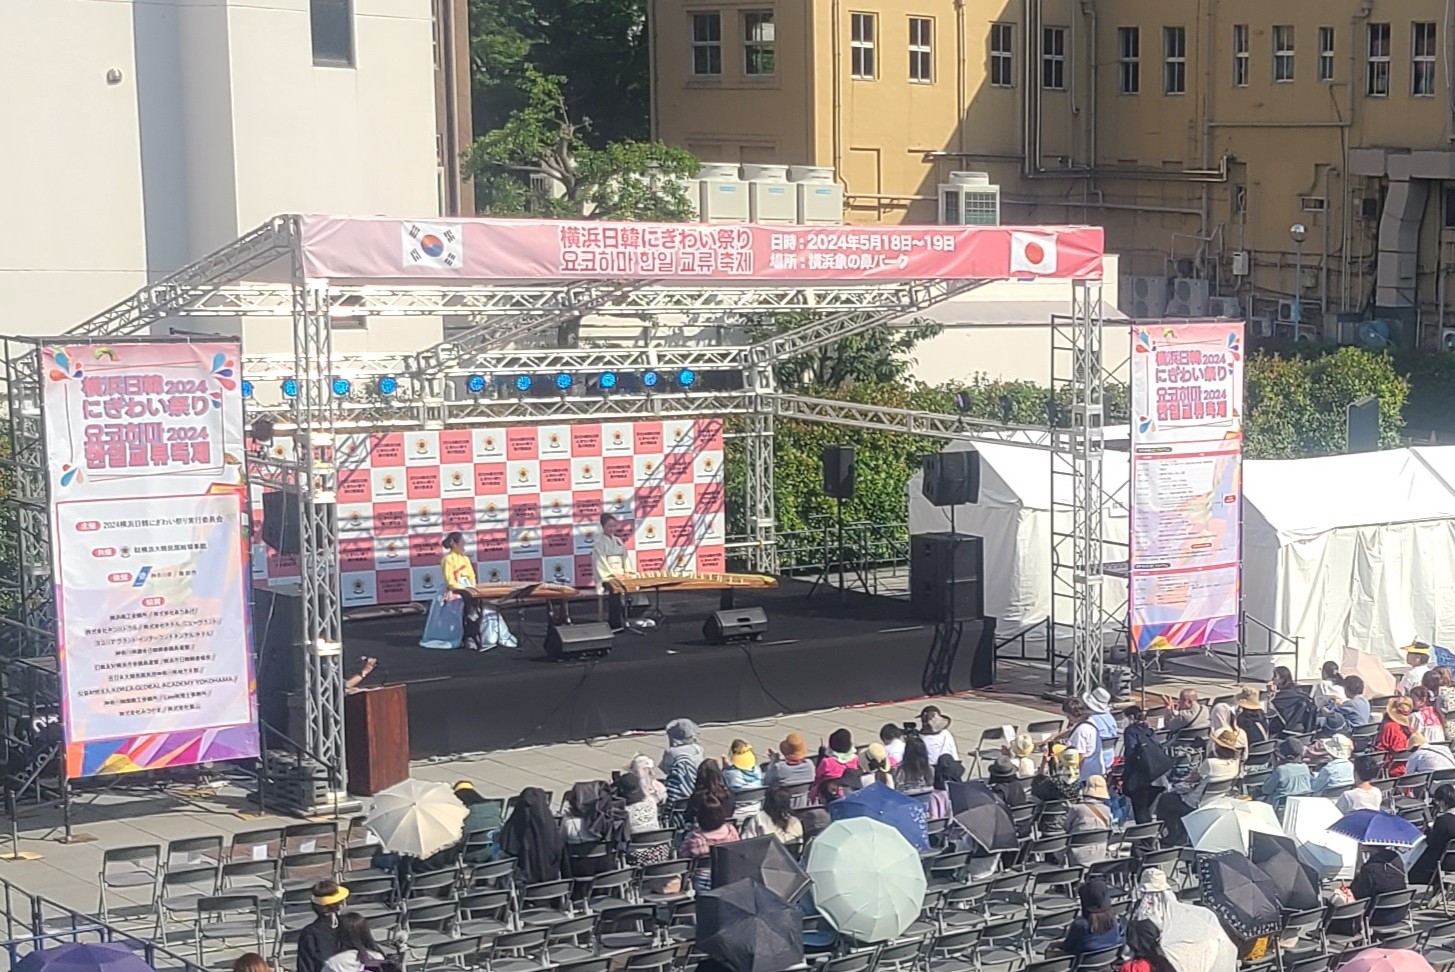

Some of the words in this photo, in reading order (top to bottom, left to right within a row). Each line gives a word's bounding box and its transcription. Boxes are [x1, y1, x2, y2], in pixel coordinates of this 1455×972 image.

[560, 226, 751, 249] 横浜日韓にぎわい祭り
[561, 250, 634, 272] 요코하마
[640, 251, 674, 272] 한일
[679, 251, 714, 272] 교류
[719, 251, 751, 272] 축제
[1202, 353, 1226, 365] 2024
[165, 379, 208, 395] 2024
[1203, 389, 1227, 400] 2024
[83, 395, 210, 419] にぎわい祭り
[84, 422, 165, 445] 요코하마
[167, 426, 209, 441] 2024
